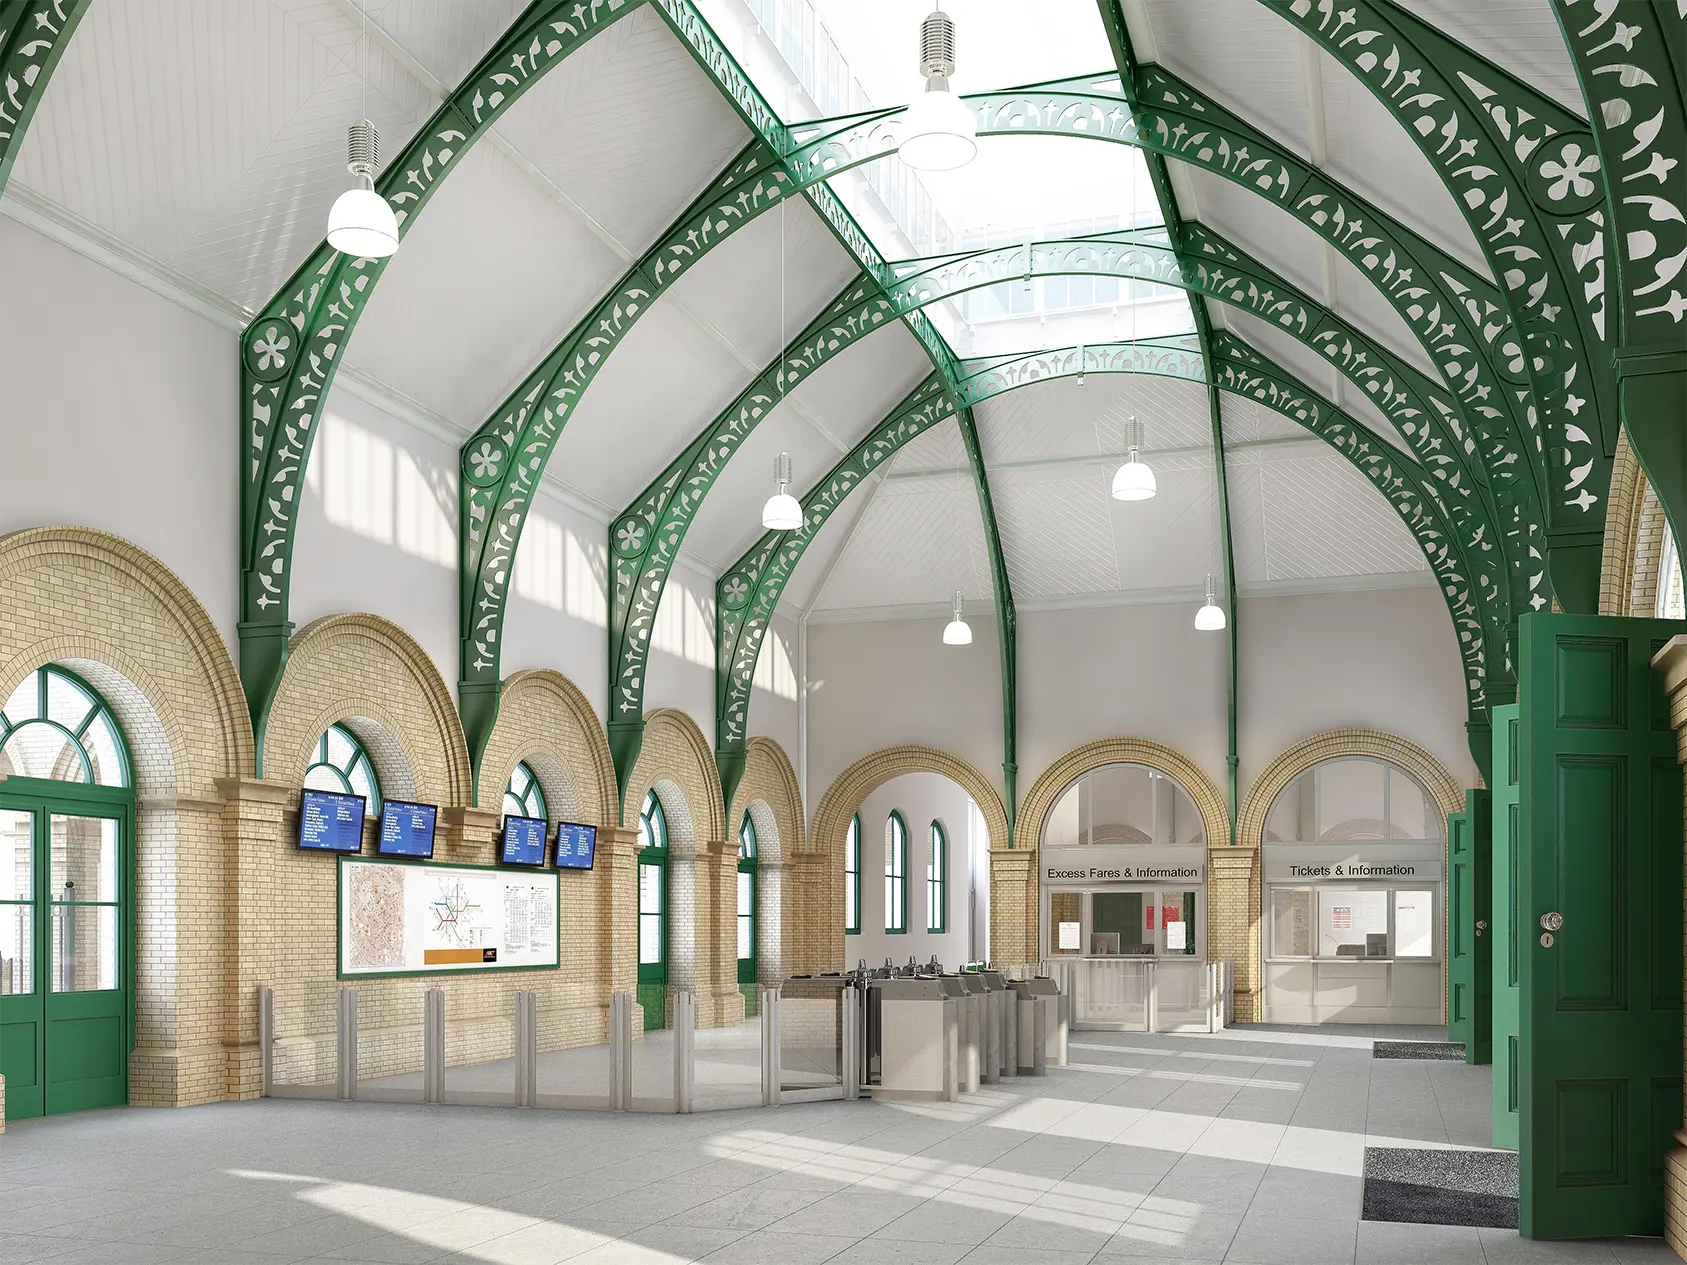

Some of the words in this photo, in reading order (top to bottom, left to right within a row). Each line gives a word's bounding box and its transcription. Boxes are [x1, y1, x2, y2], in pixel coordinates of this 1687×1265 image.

[1047, 868, 1086, 879] Excess
[1089, 867, 1120, 879] Fares
[1124, 867, 1133, 878] &
[1136, 867, 1198, 878] Information
[1290, 865, 1331, 876] Tickets
[1335, 865, 1344, 876] &
[1348, 864, 1415, 876] Information
